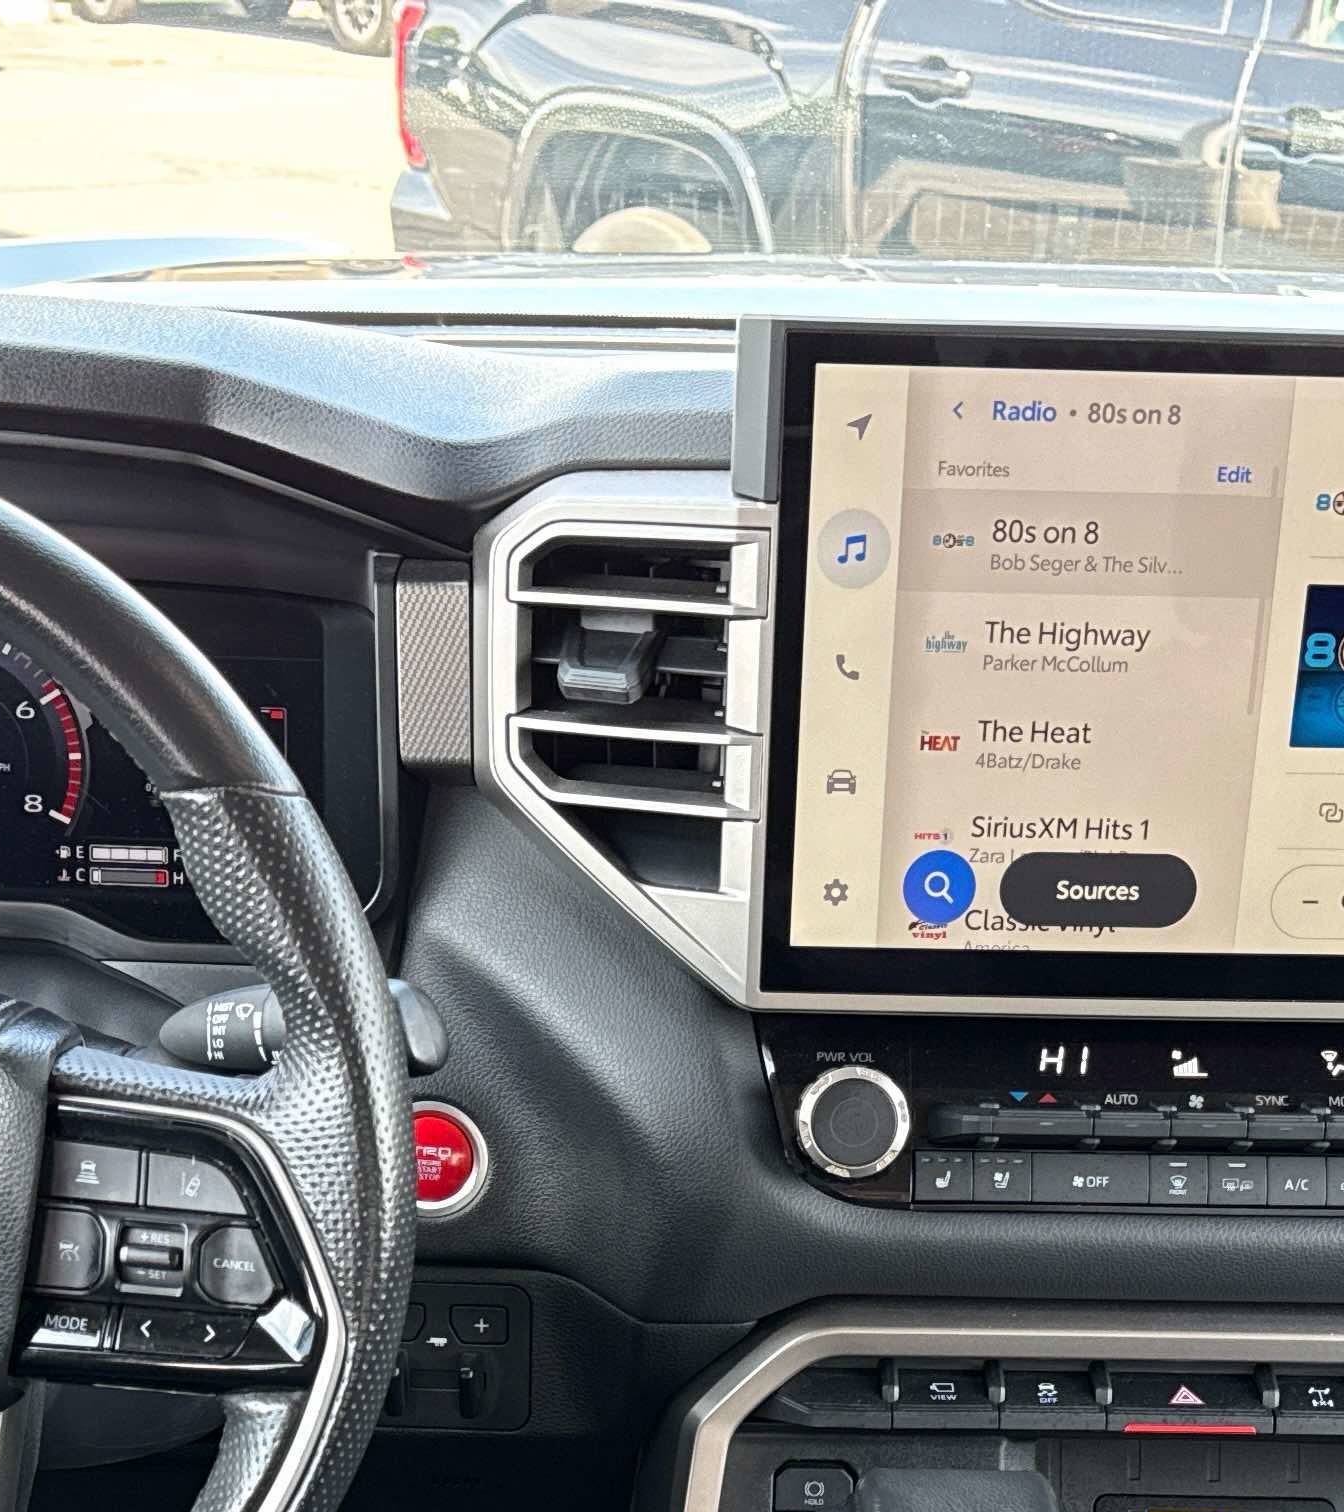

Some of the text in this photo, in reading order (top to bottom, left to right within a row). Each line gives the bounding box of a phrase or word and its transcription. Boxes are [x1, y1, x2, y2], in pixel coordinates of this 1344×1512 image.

[992, 400, 1181, 425] Radio 80s on 8
[937, 460, 1010, 479] Favorites
[1217, 466, 1252, 483] Edit
[992, 519, 1100, 545] 80s on 8
[990, 554, 1026, 572] Bob
[1030, 555, 1082, 576] Seger
[1084, 557, 1097, 572] &
[1103, 556, 1134, 573] The
[985, 621, 1151, 652] The Highway
[983, 655, 1129, 673] Parker McCollum
[16, 701, 35, 719] 6
[978, 720, 1092, 744] The Heat
[919, 735, 961, 752] HEAT
[975, 753, 1081, 772] 4Batz/Drake
[24, 795, 43, 812] 8
[914, 831, 942, 841] HITS
[971, 816, 1150, 841] SiriusXM Hits 1
[76, 846, 84, 858] E
[969, 847, 1005, 864] Zara
[76, 869, 184, 885] C H
[1056, 879, 1140, 901] Sources
[816, 1052, 876, 1063] PWR VOL
[1104, 1094, 1138, 1105] AUTO
[1256, 1095, 1289, 1107] SYNC
[1086, 1176, 1109, 1188] OFF
[1284, 1178, 1309, 1191] A/C
[213, 1257, 256, 1273] CANCEL
[44, 1313, 89, 1331] MODE
[930, 1393, 957, 1401] VIEW
